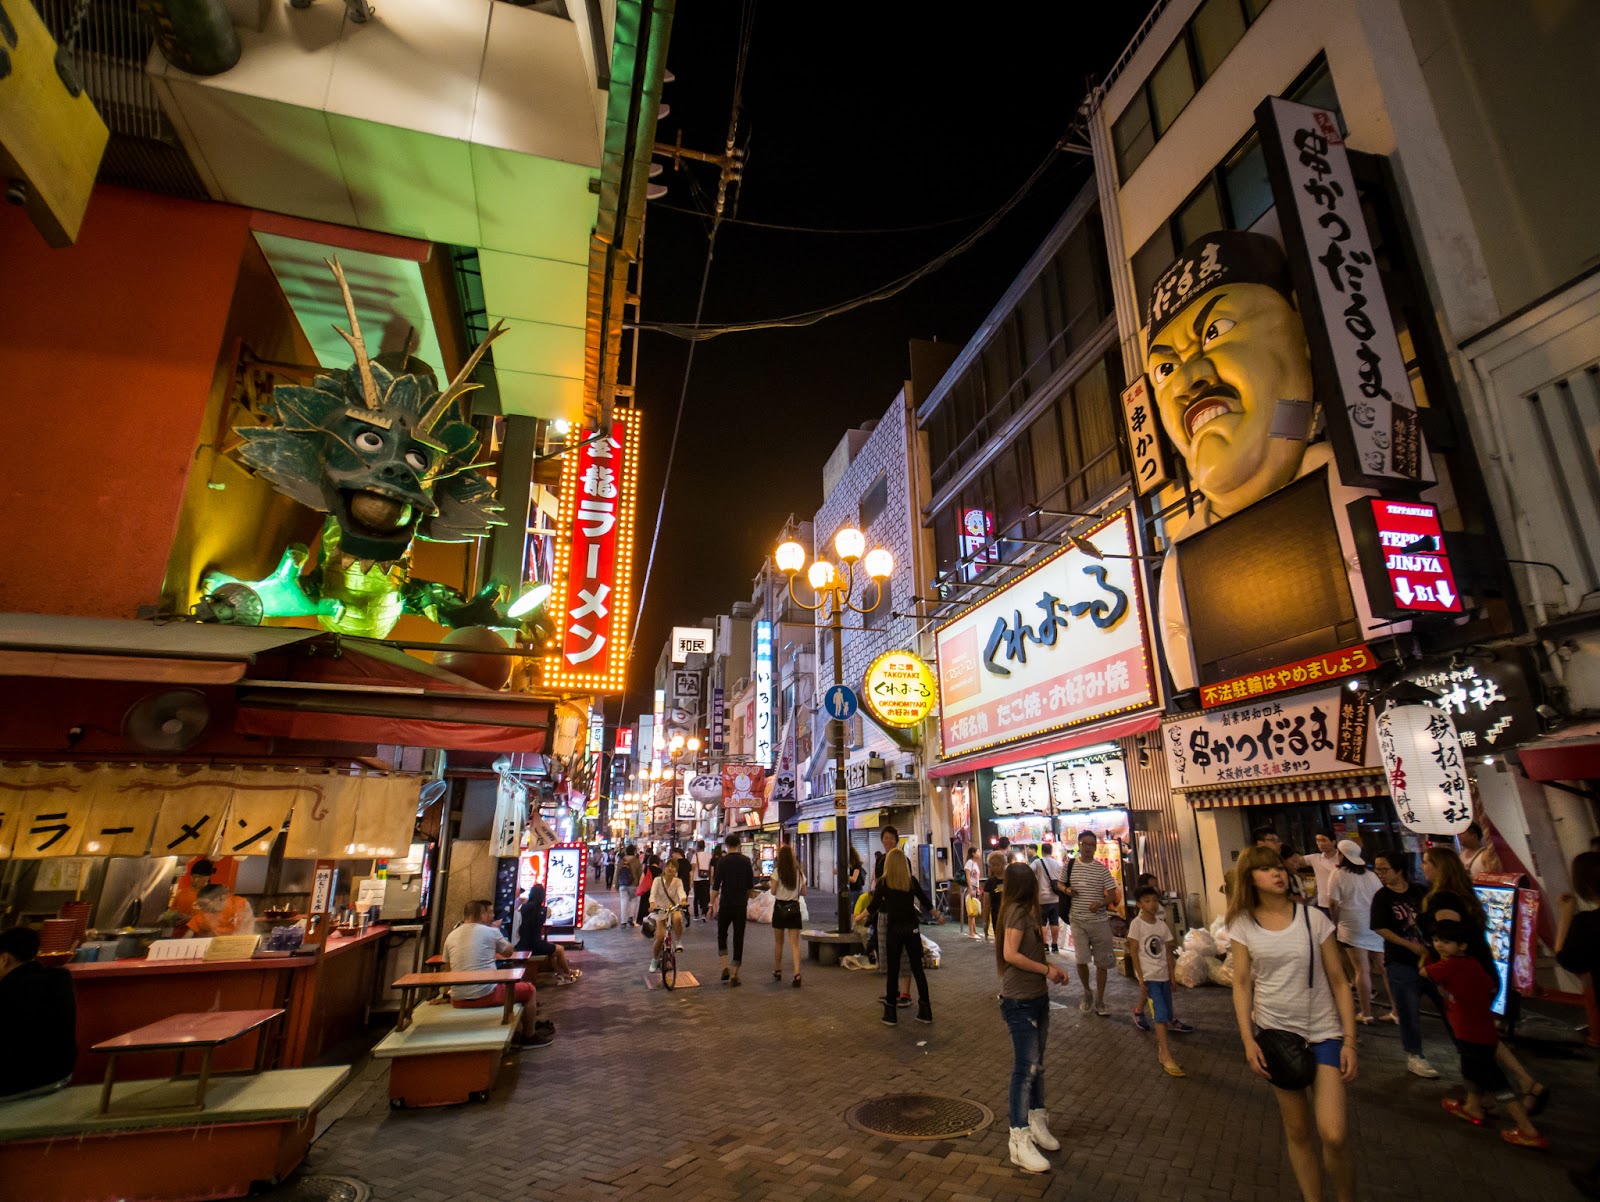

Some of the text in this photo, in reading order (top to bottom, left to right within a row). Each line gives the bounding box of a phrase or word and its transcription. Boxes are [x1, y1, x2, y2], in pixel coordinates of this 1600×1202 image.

[1294, 128, 1392, 401] 串かつだるま
[1153, 243, 1221, 320] だるま
[1131, 405, 1157, 482] 串かつ
[1386, 505, 1433, 517] TEPPANYAKI
[565, 429, 622, 666] 金龍ラーメン
[1386, 554, 1443, 573] JINJYA
[1413, 586, 1435, 602] B1
[983, 564, 1128, 675] くれおーる
[680, 640, 705, 652] 和民
[883, 671, 920, 679] TAKOYAKI
[889, 663, 913, 671] たこ焼
[1203, 650, 1367, 705] 不法駐輪はやめましょう
[874, 681, 931, 697] くれおーる
[757, 673, 770, 758] いろりや
[879, 700, 926, 708] OKONOMIYAKI
[887, 708, 919, 717] お好み焼
[1221, 702, 1284, 727] 創業昭和四年
[950, 709, 988, 742] 大阪名物
[1190, 706, 1335, 774] 串かつだるま
[1424, 714, 1471, 825] 鉄板神社
[0, 812, 273, 851] ラーメン
[547, 885, 576, 893] ラーメン
